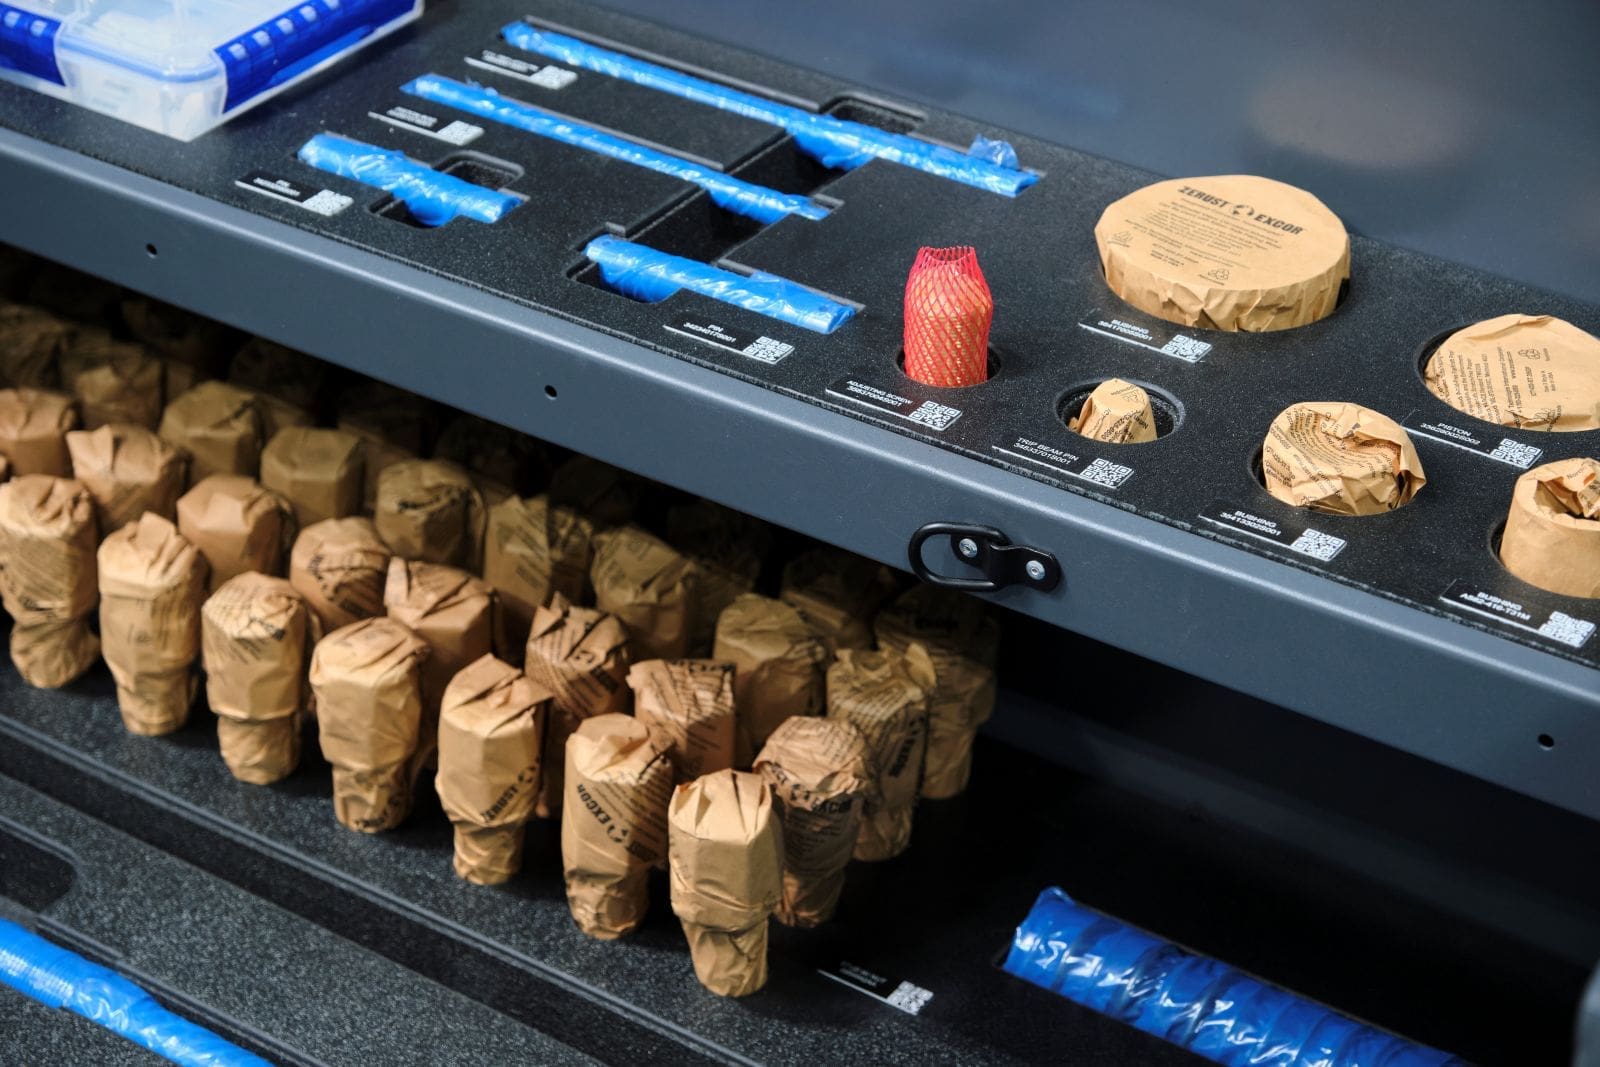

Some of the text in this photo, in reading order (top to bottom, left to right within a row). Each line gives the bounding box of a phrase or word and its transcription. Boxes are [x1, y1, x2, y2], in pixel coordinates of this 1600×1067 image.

[1177, 185, 1306, 235] ZERUST EXCOR
[707, 324, 724, 332] PIN
[1437, 422, 1472, 437] PISTON
[1018, 437, 1079, 461] TRIP BEAM PIN
[1235, 510, 1277, 528] BUSHING
[1477, 591, 1522, 611] BUSHING
